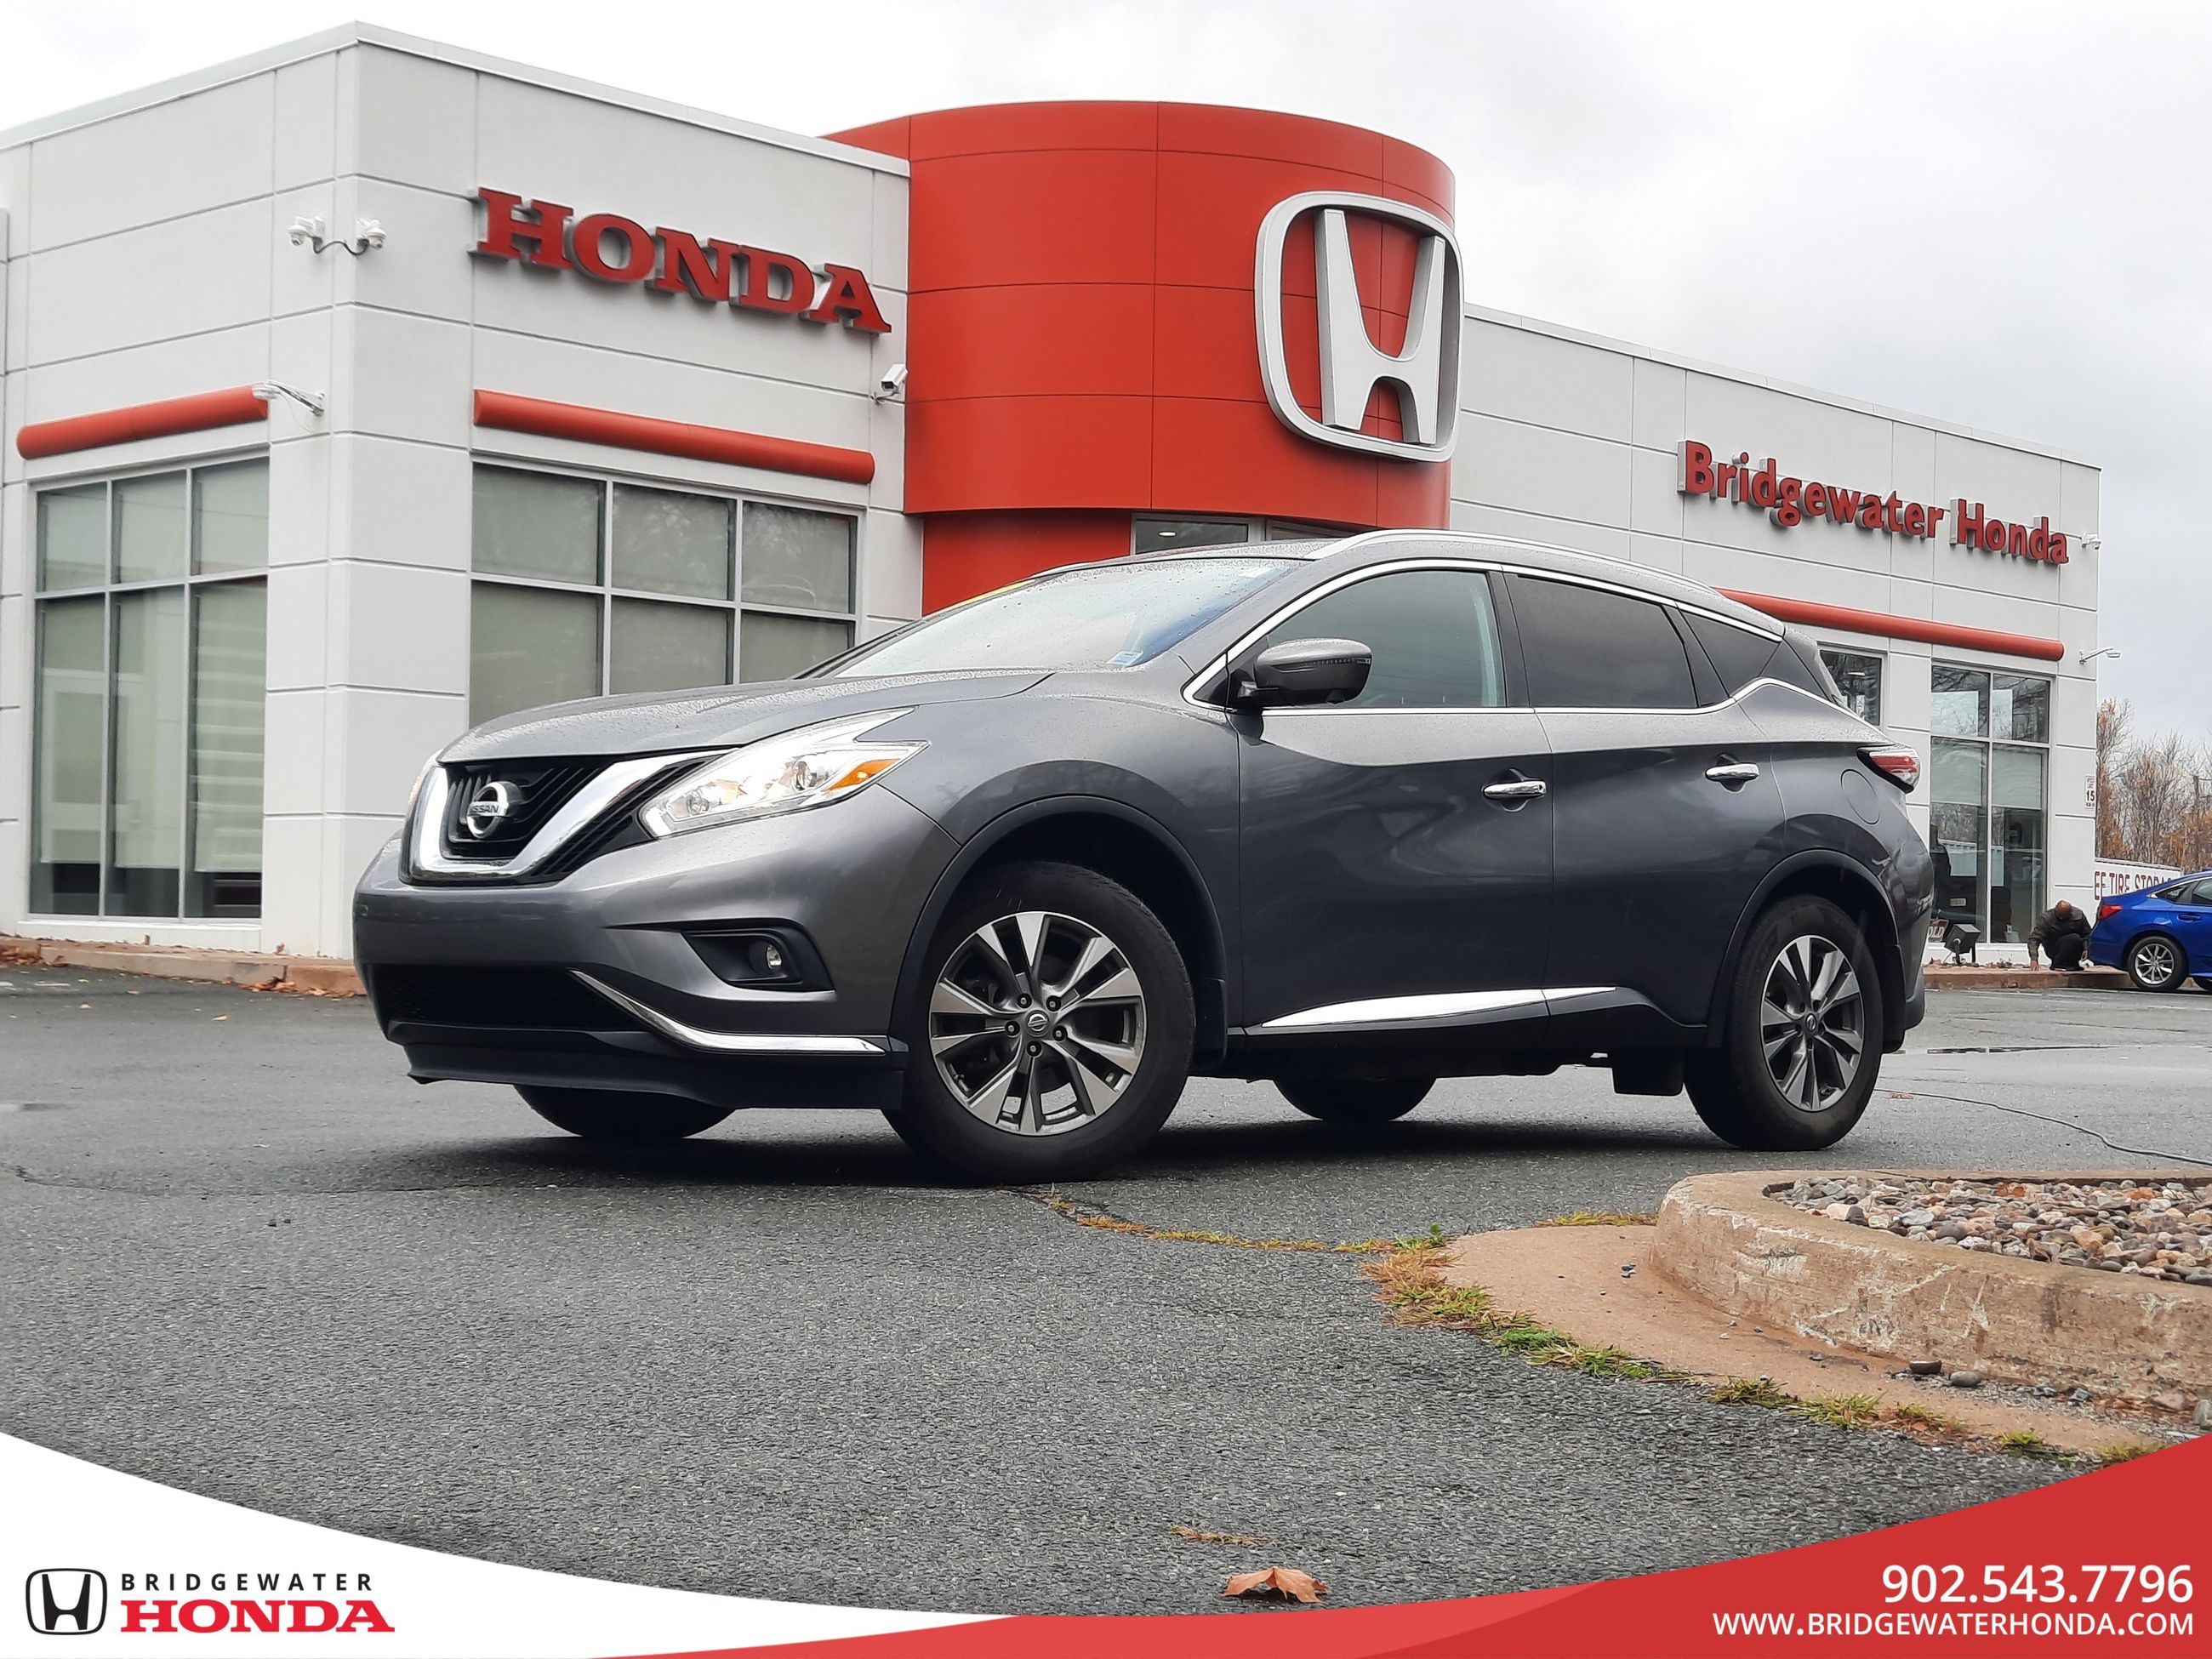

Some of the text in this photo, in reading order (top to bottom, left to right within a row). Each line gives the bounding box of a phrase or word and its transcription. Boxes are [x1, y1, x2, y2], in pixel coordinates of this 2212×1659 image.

[476, 187, 892, 334] HONDA
[1680, 439, 2070, 566] Bridgewater Honda
[2086, 790, 2095, 801] 15
[470, 804, 500, 814] SSAN
[1928, 926, 1945, 938] OLD
